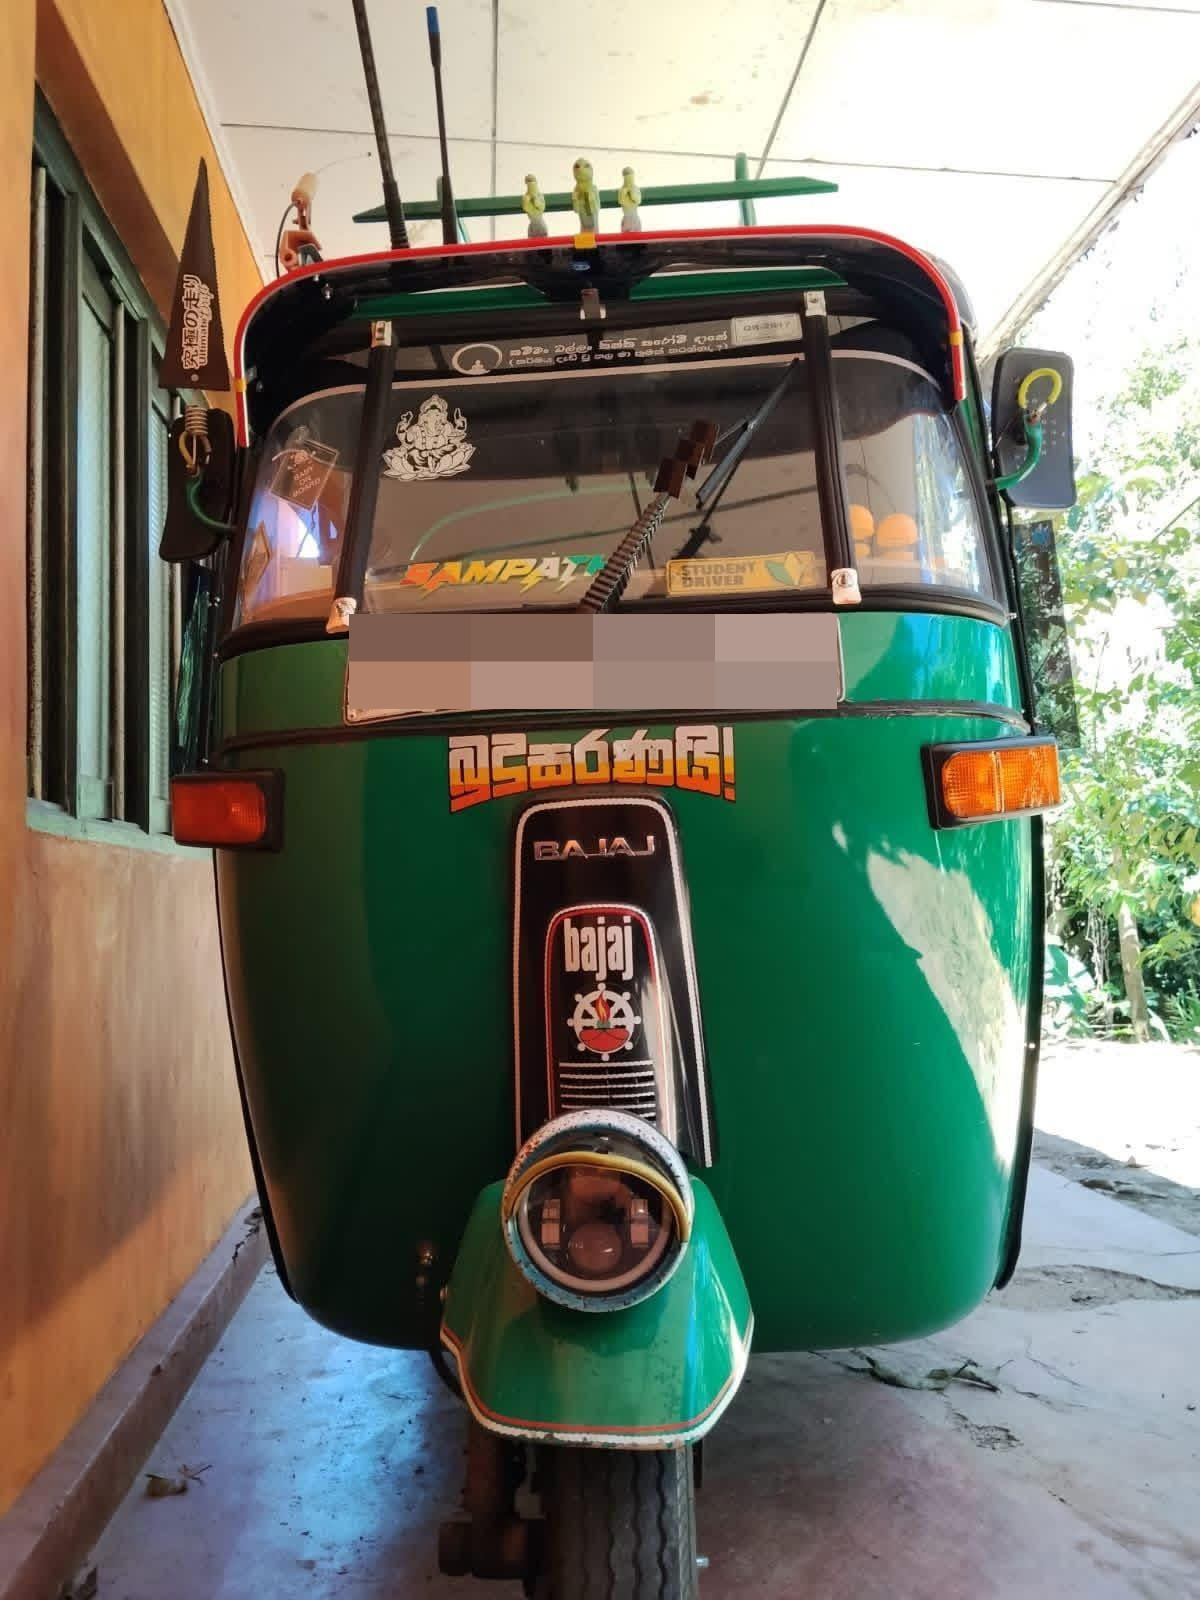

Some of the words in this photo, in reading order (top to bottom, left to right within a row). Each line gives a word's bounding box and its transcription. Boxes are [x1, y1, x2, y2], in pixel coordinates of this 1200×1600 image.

[682, 560, 756, 577] STUDENT
[682, 575, 744, 588] DRIVER
[534, 835, 656, 861] BAJAJ
[563, 916, 634, 981] bajaj
